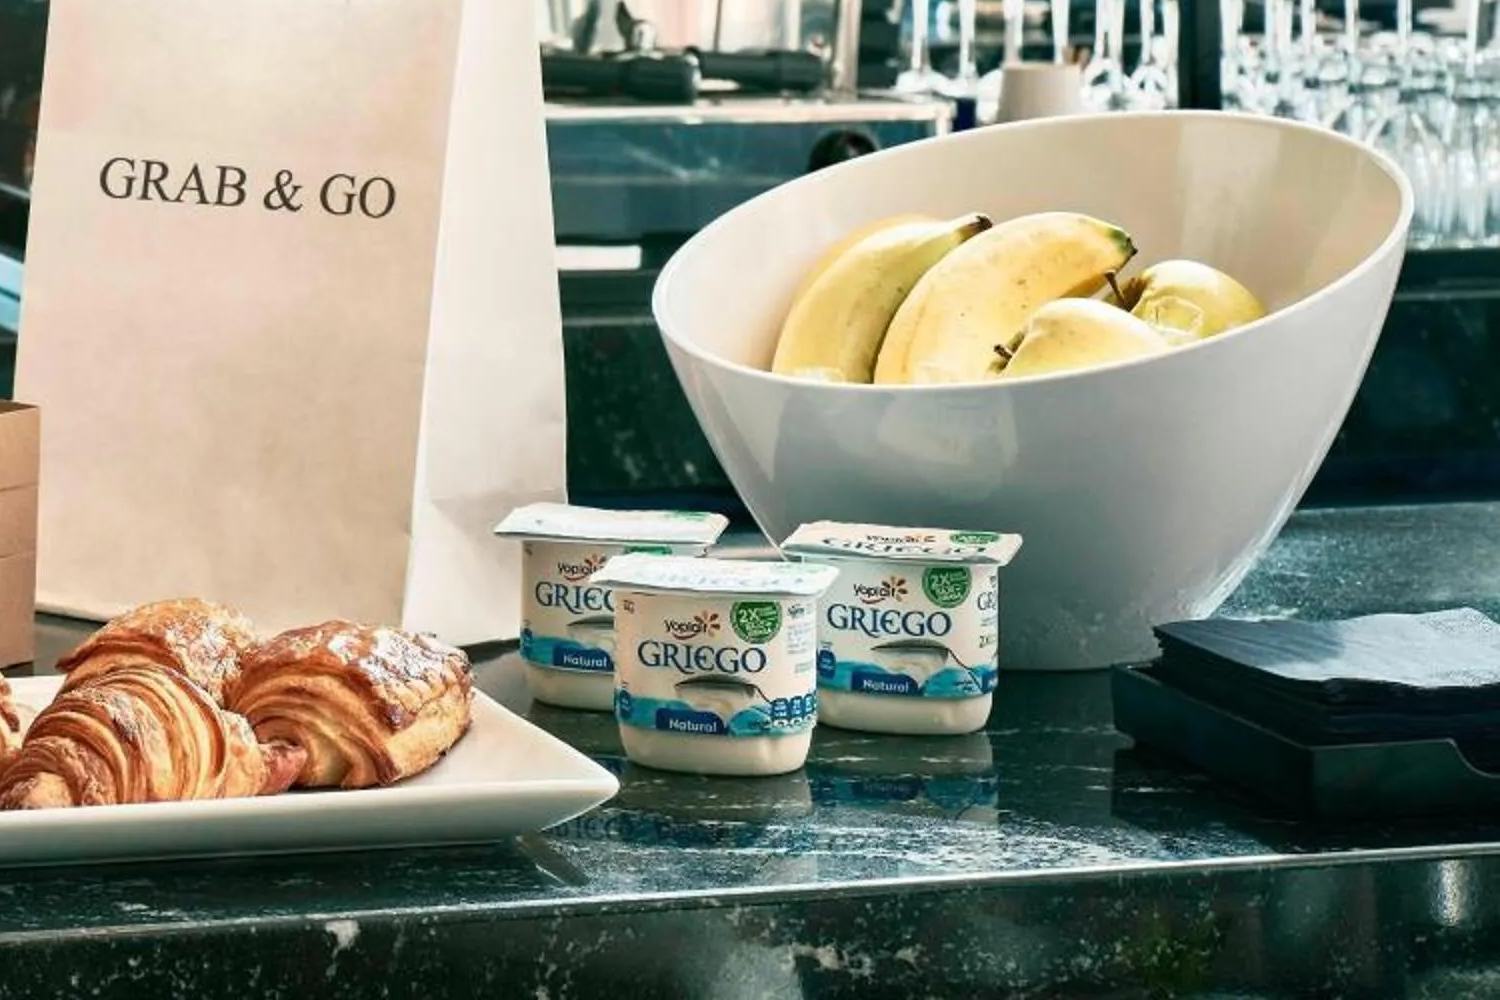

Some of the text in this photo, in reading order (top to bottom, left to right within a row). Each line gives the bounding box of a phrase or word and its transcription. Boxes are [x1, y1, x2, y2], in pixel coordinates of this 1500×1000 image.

[99, 157, 397, 218] GRAB & GO
[535, 581, 615, 614] GRIE
[853, 583, 896, 598] Yoplait
[663, 618, 709, 635] Yoplait
[827, 603, 953, 638] GRIEGO
[562, 654, 608, 668] Natural
[637, 640, 767, 675] GRIEGO
[862, 679, 910, 693] Natural
[668, 718, 718, 733] Natural
